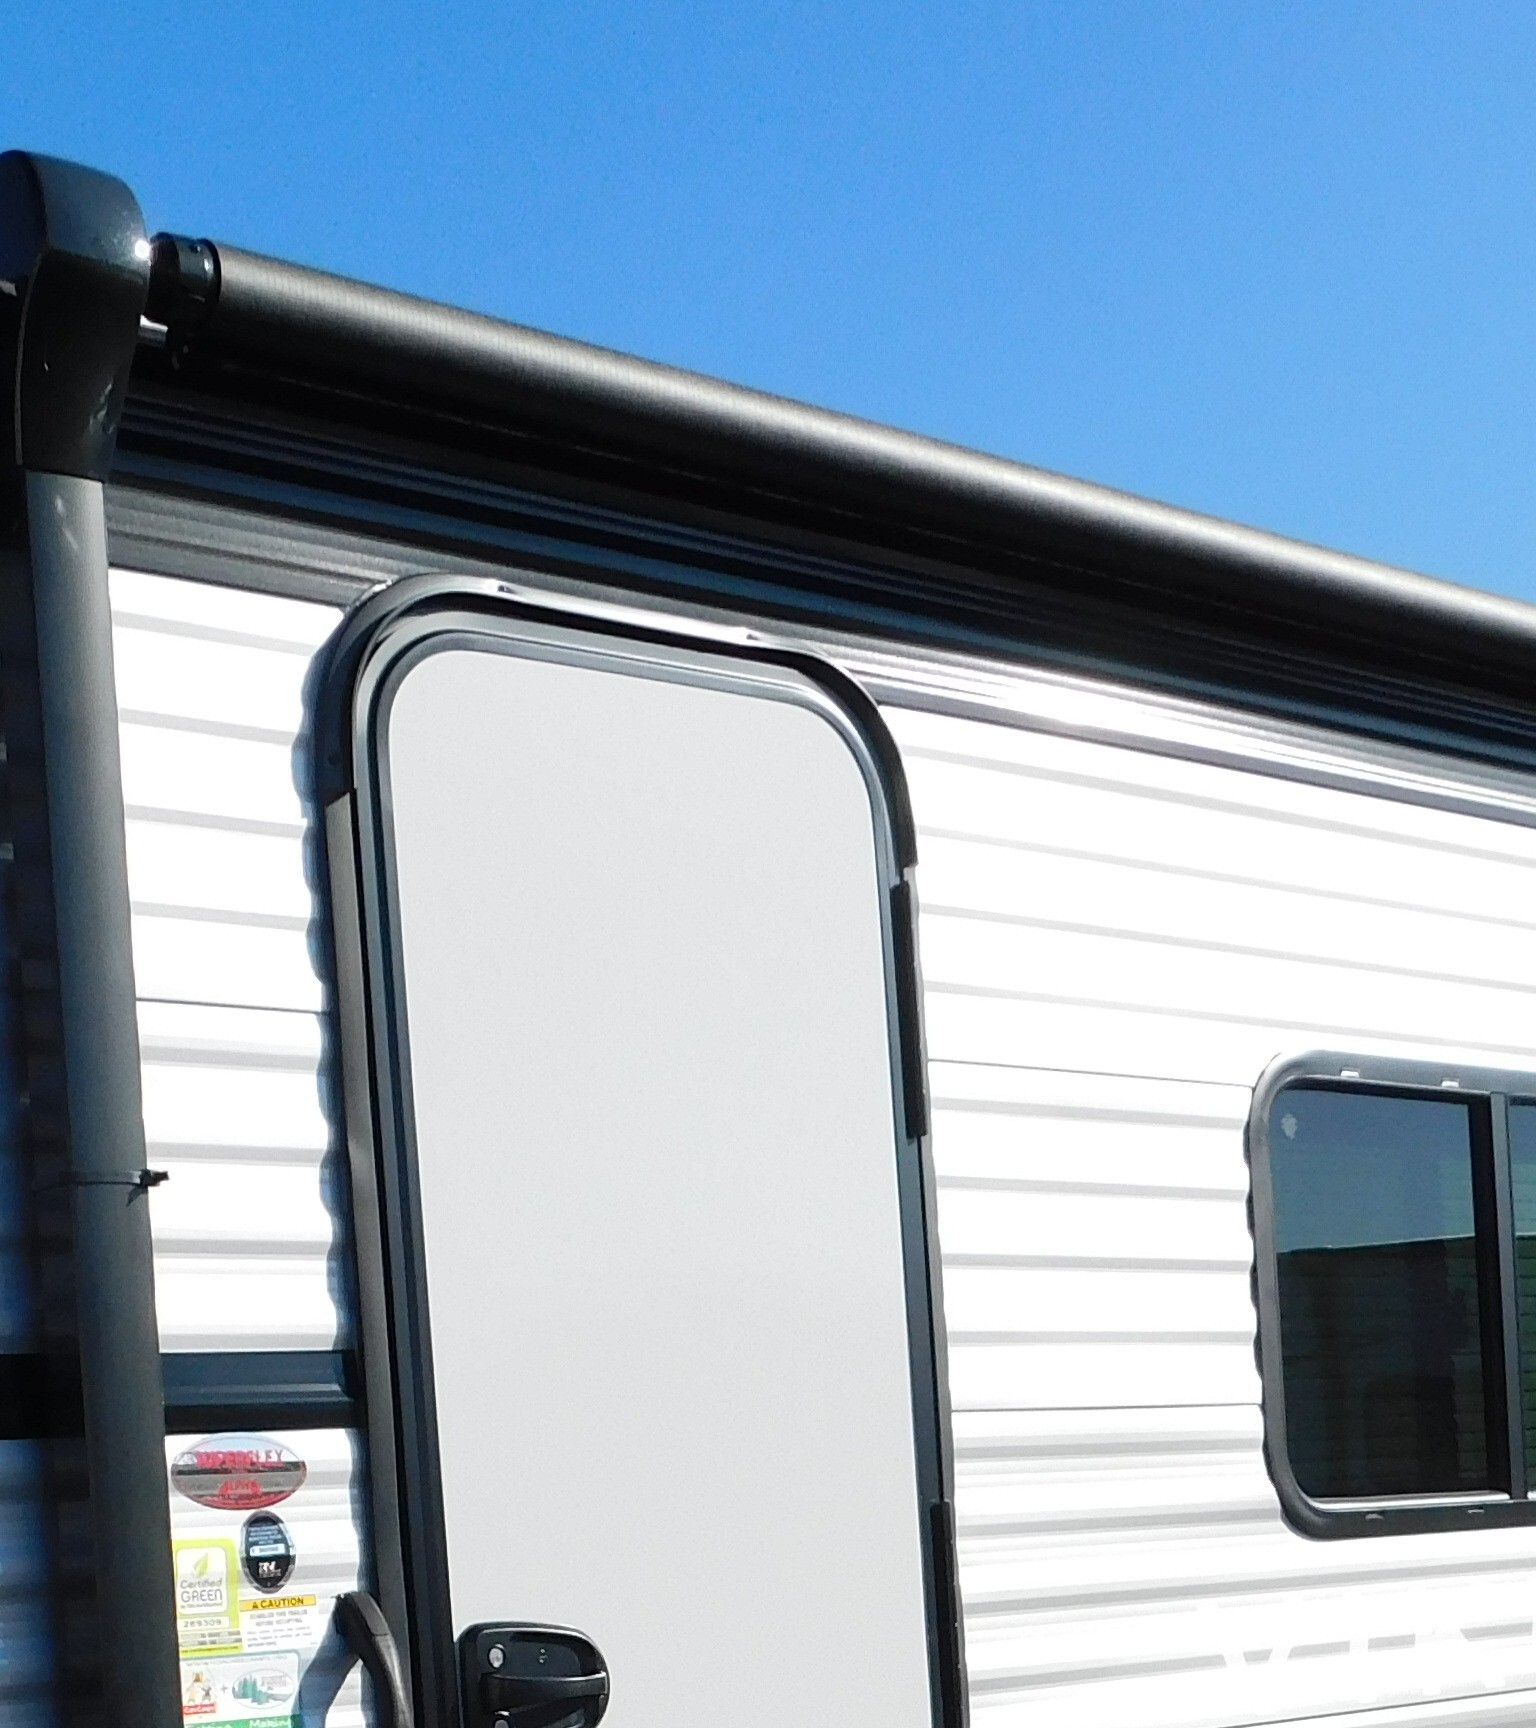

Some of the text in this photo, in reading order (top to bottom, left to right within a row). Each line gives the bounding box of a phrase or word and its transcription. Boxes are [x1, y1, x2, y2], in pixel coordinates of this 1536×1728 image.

[180, 1577, 224, 1590] Certified
[180, 1589, 224, 1602] GREEN
[261, 1597, 305, 1609] CAUTION
